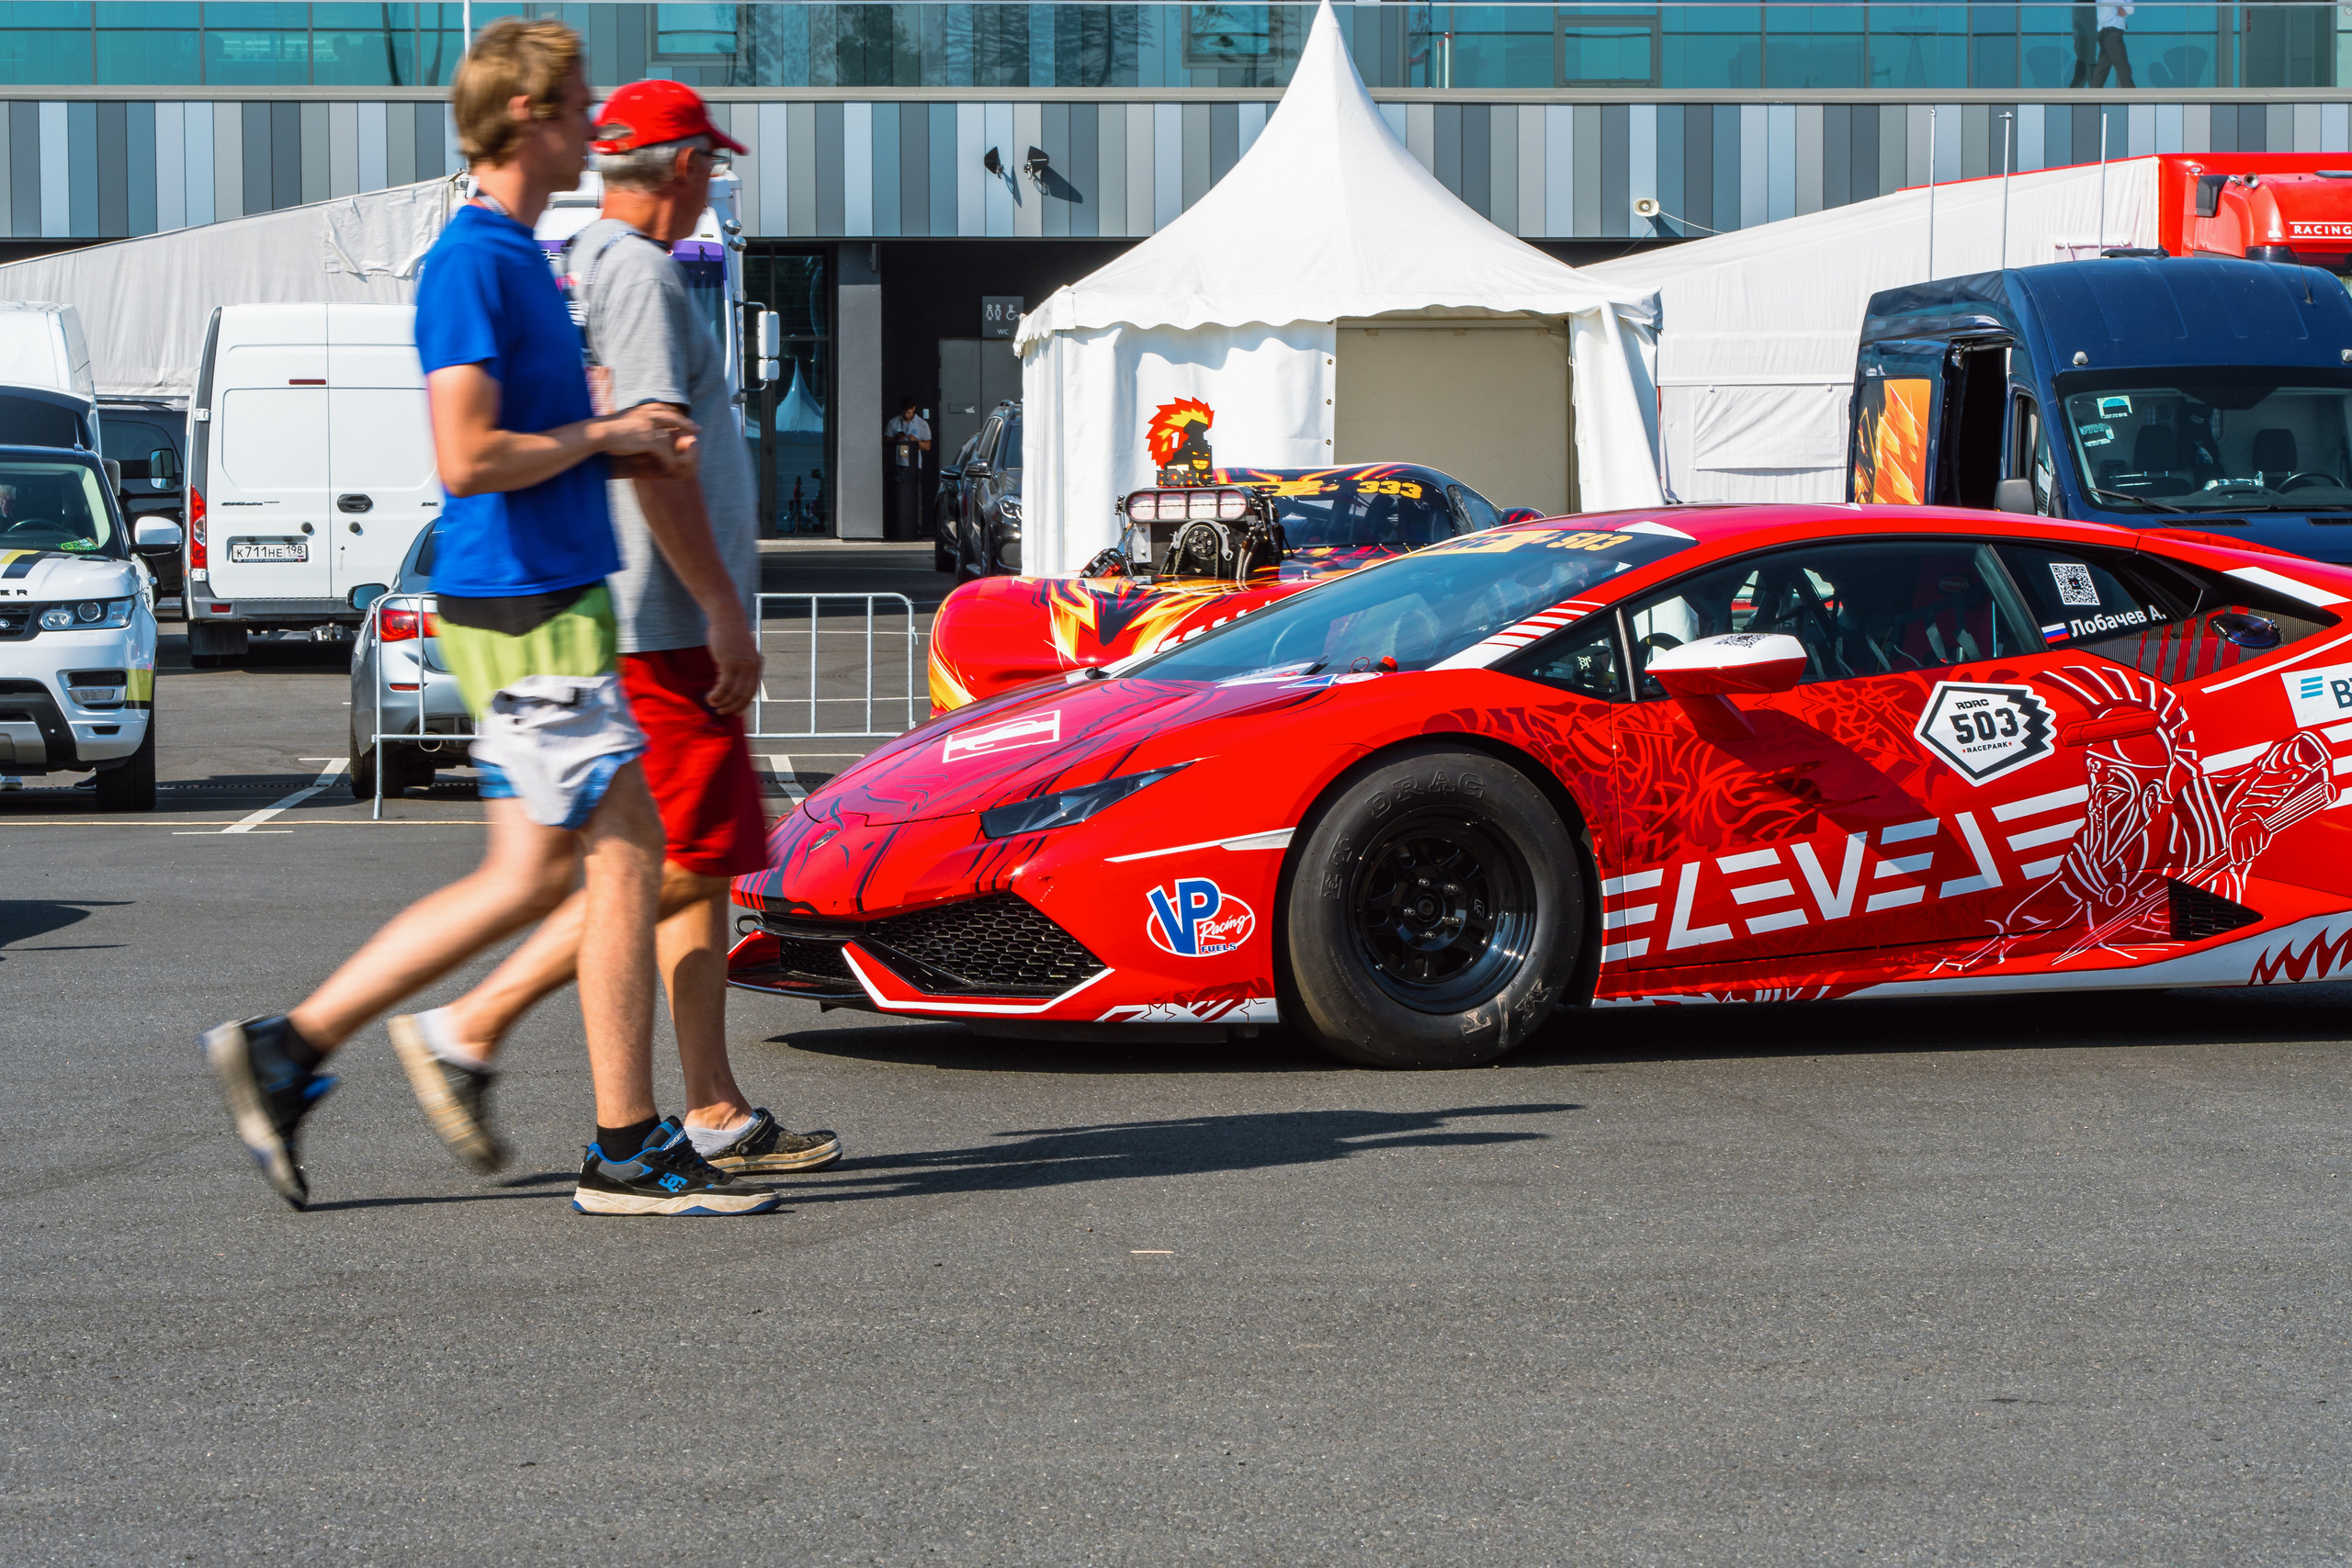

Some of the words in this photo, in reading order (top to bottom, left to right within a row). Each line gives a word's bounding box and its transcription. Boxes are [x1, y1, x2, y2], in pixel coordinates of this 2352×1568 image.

[2293, 224, 2352, 235] RACING
[1170, 432, 1180, 449] 1
[1356, 480, 1423, 499] 333
[286, 545, 303, 555] 198
[1546, 532, 1634, 551] 503
[2070, 610, 2147, 637] Лобачев
[1955, 699, 1990, 709] RDRC
[1949, 707, 2019, 745] 503
[1966, 741, 2008, 753] RACEPARK
[1364, 771, 1486, 819] DRAG
[1146, 877, 1222, 956] VP
[1199, 914, 1249, 945] Racing
[1201, 943, 1238, 953] FUELS
